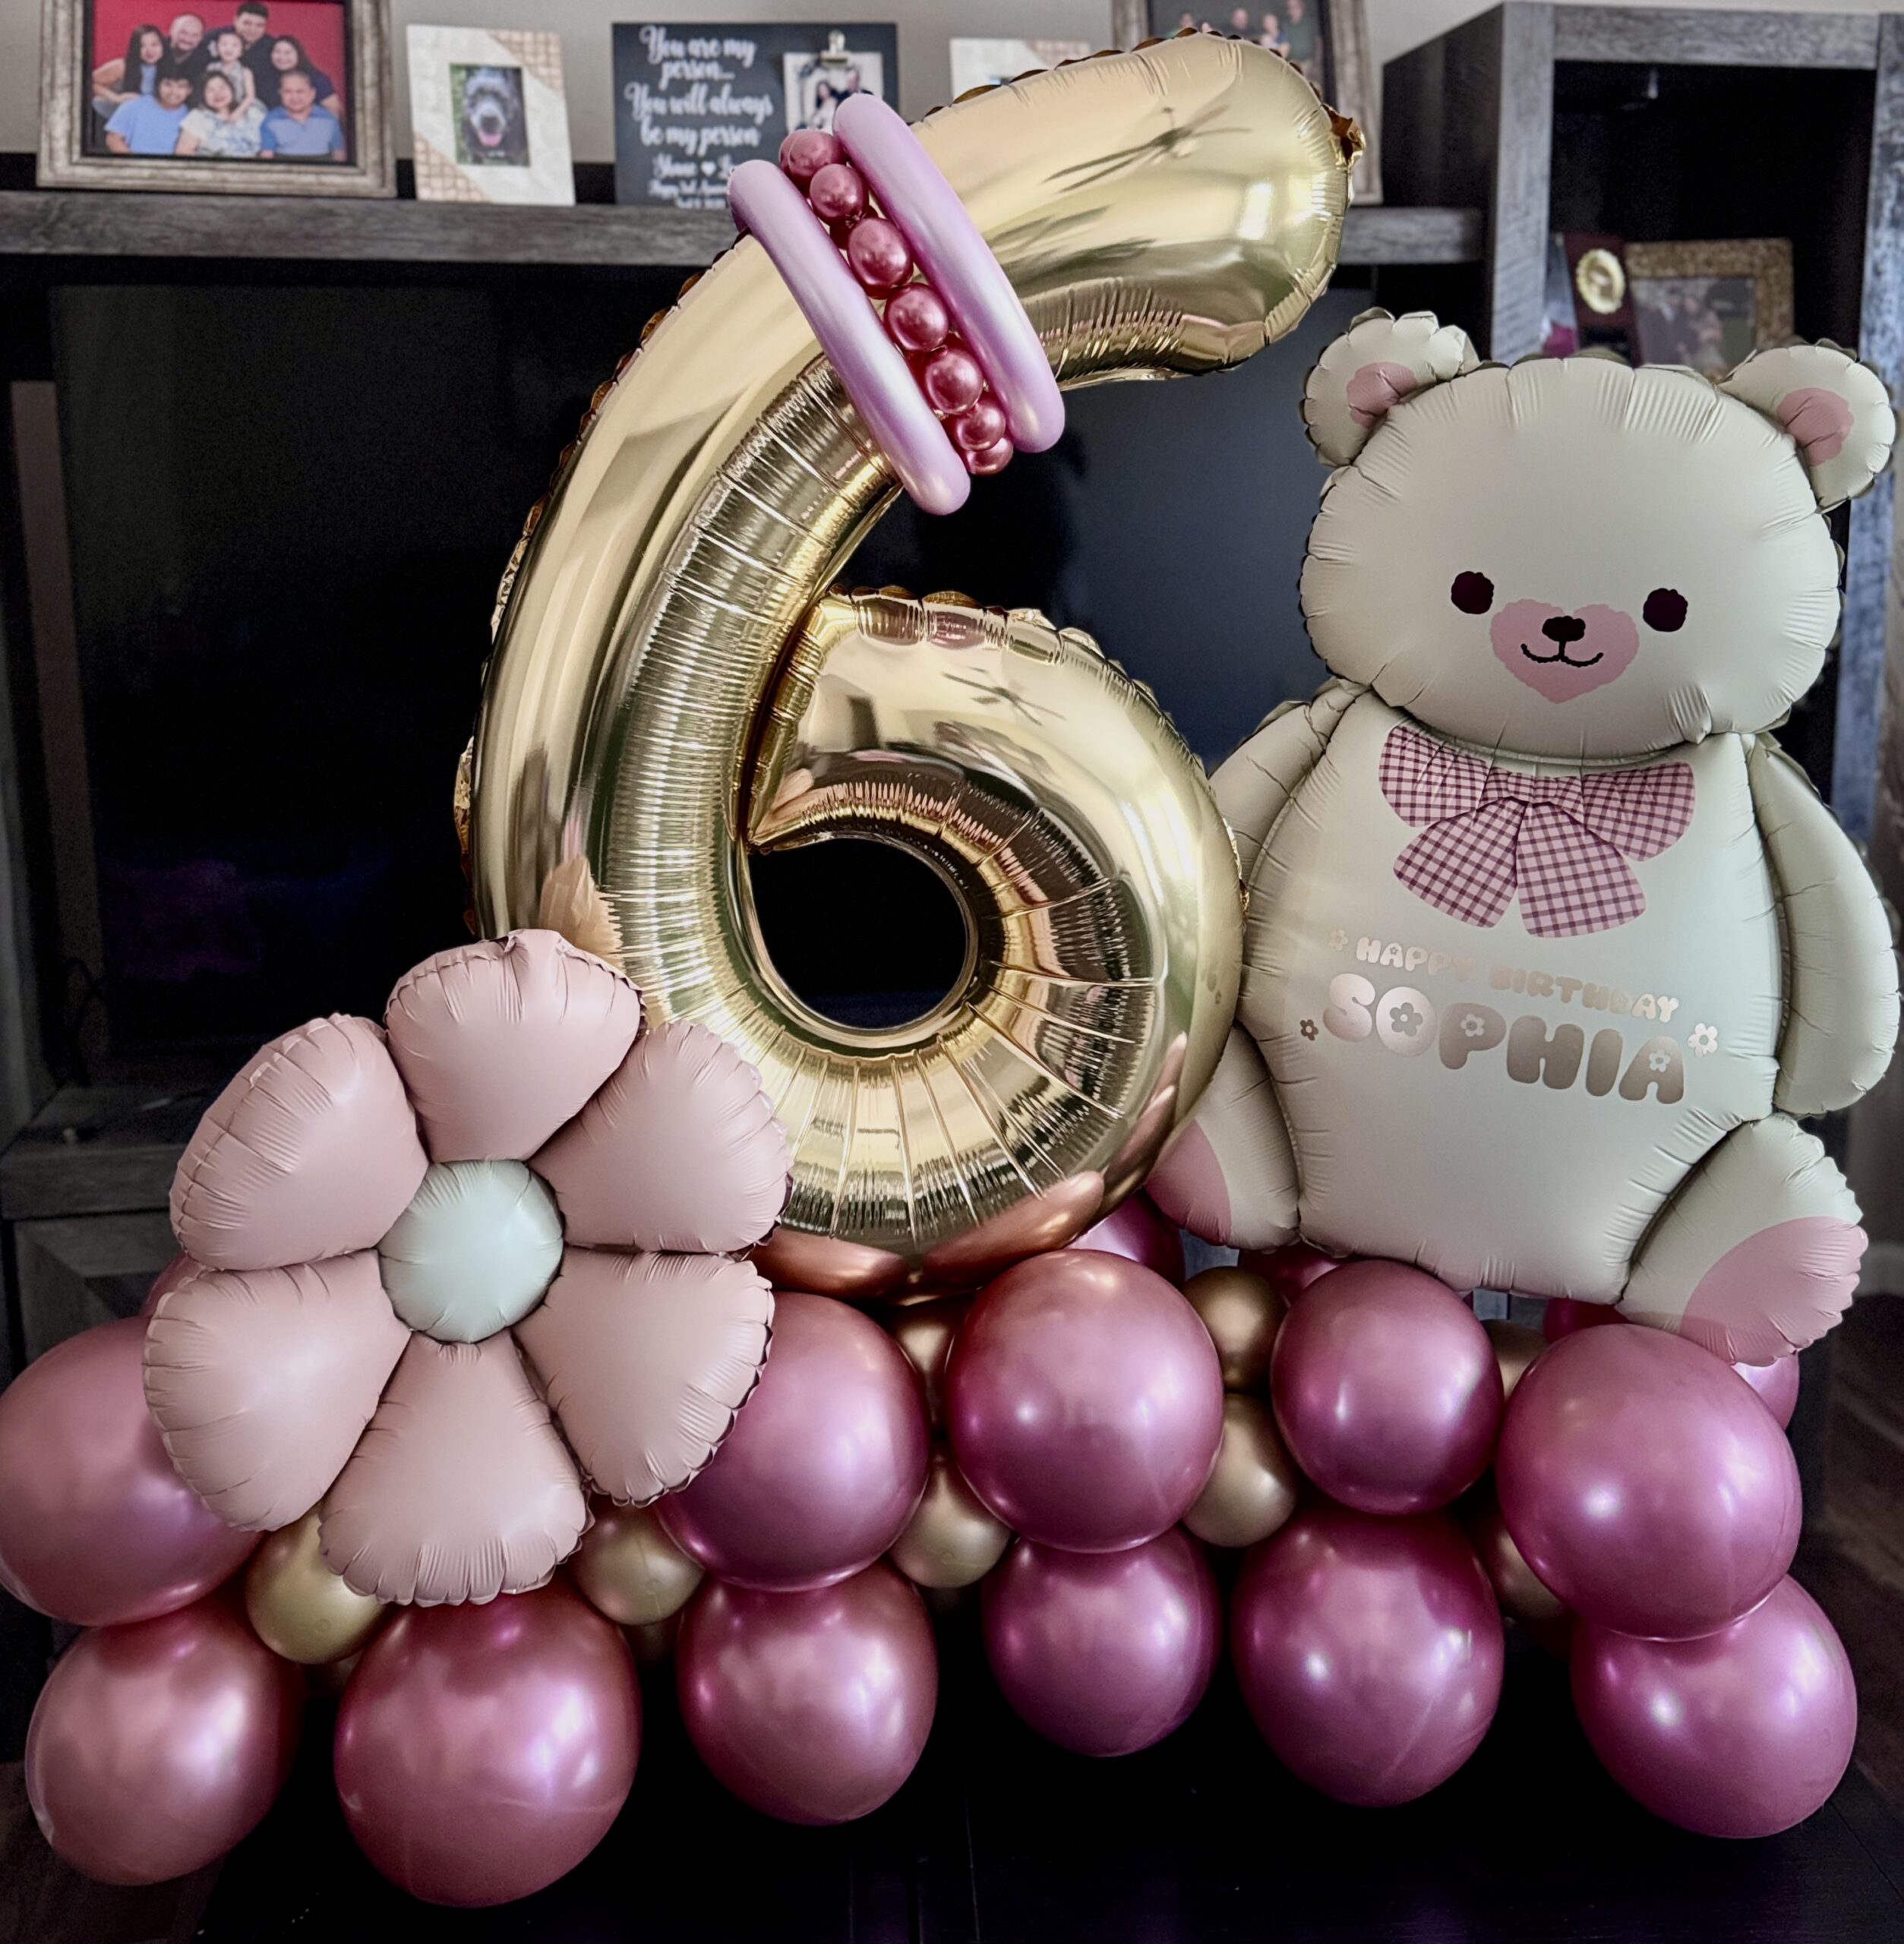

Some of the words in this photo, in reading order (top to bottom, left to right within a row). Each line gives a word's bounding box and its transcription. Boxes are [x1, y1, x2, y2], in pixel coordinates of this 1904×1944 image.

[639, 25, 684, 64] You
[687, 38, 721, 56] are
[724, 39, 757, 68] my
[624, 81, 668, 122] You
[670, 83, 708, 115] will
[709, 83, 774, 125] always
[640, 116, 665, 146] be
[666, 127, 698, 156] my
[699, 126, 761, 156] person
[1356, 936, 1473, 980] HAPPY
[1489, 964, 1679, 1023] BIRTHDAY
[1322, 973, 1685, 1104] SOPHIA
